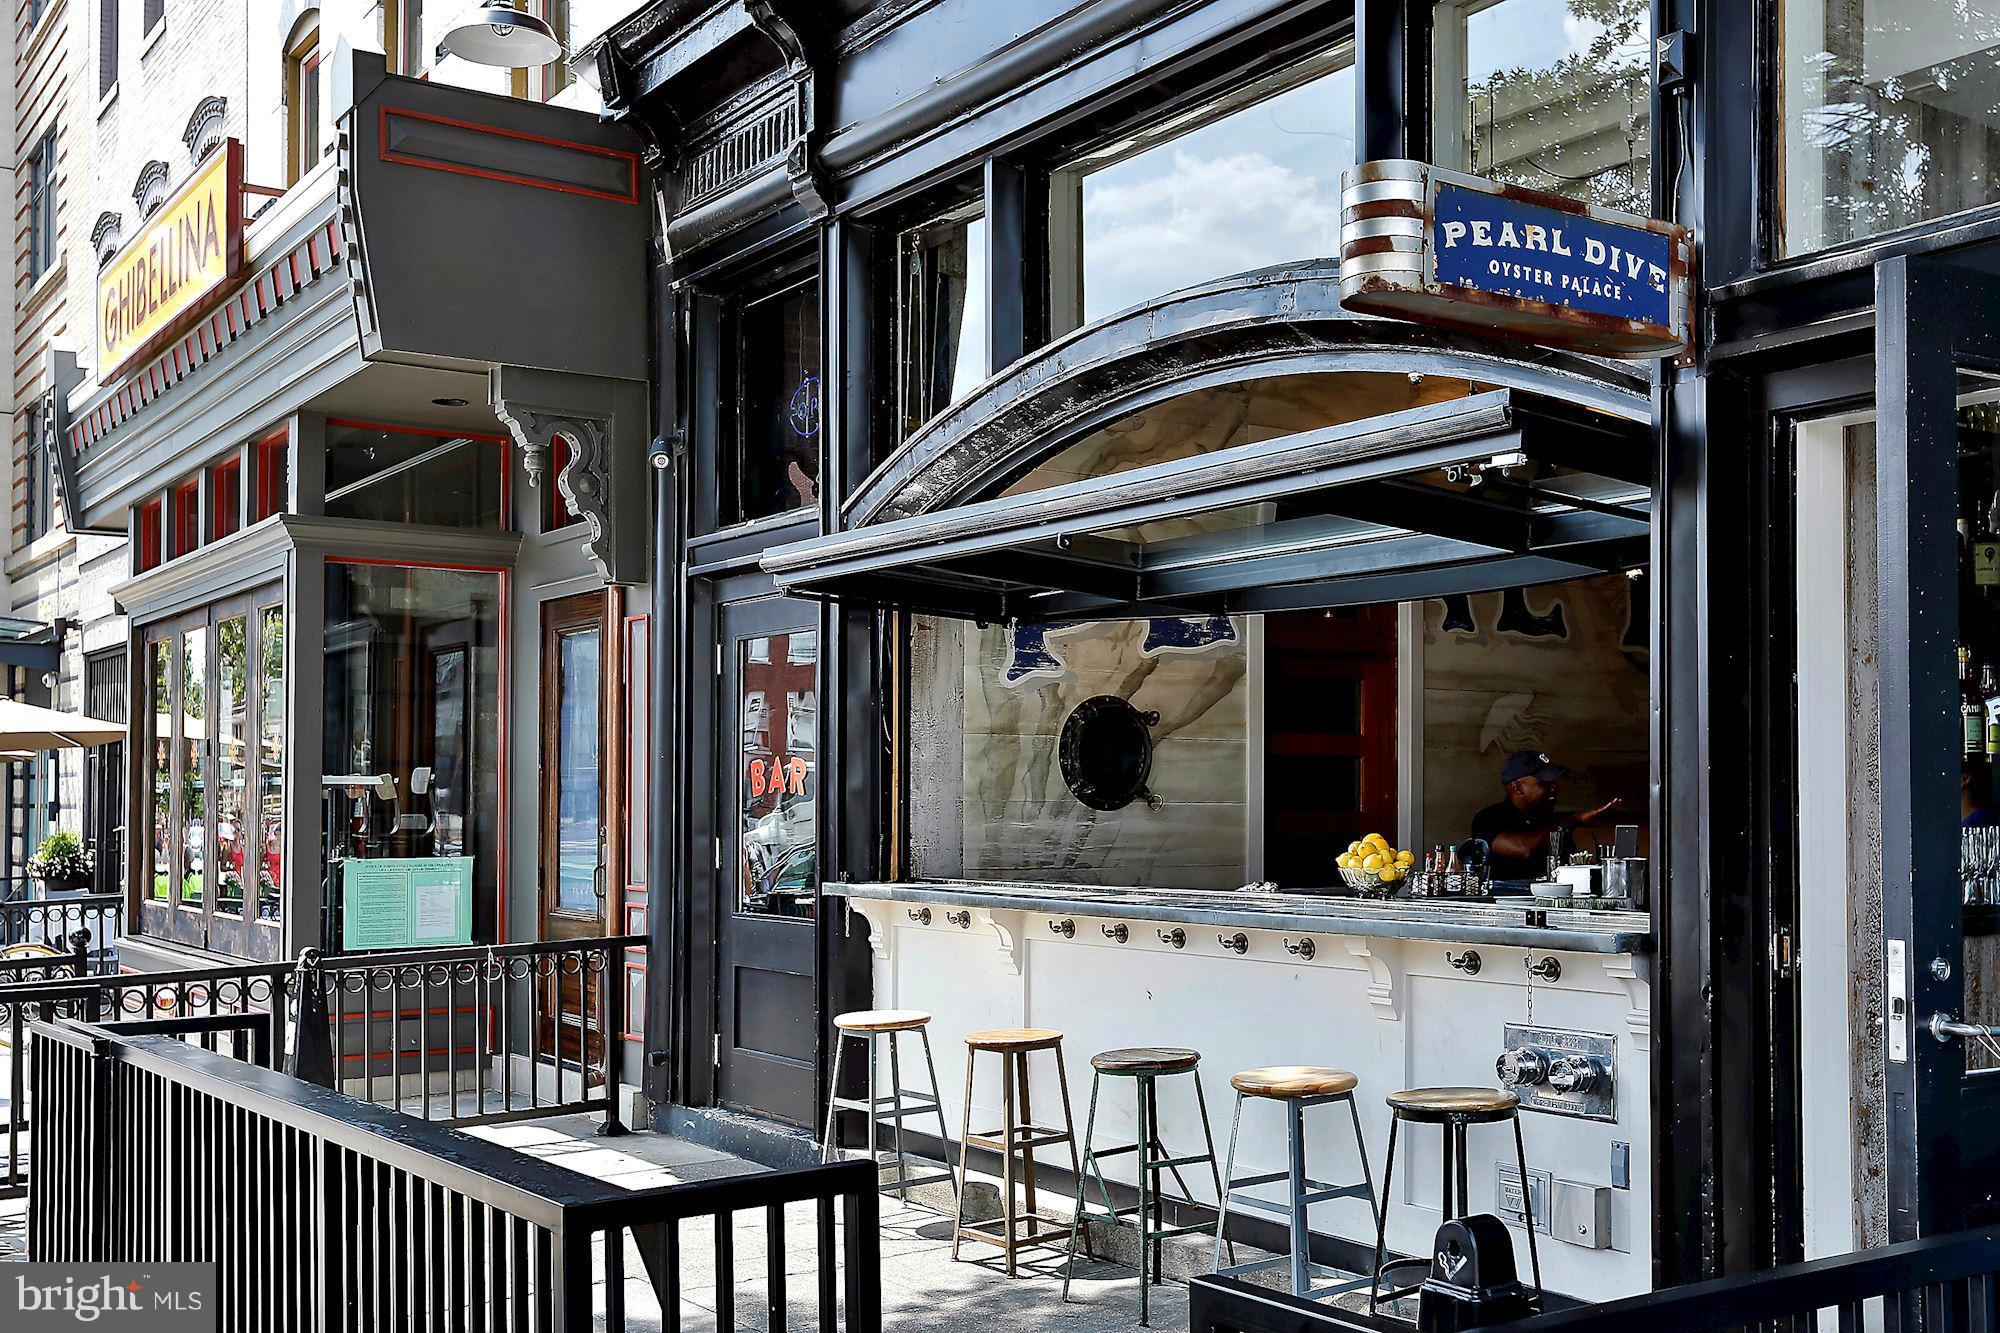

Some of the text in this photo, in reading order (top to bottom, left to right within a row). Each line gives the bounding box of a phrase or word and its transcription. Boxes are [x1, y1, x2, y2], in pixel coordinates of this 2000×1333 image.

[104, 189, 220, 353] GHIBELLINA
[1442, 220, 1668, 294] PEARL DIVE
[1488, 259, 1554, 287] OYSTER
[1561, 275, 1622, 300] PALACE
[750, 755, 808, 798] BAR
